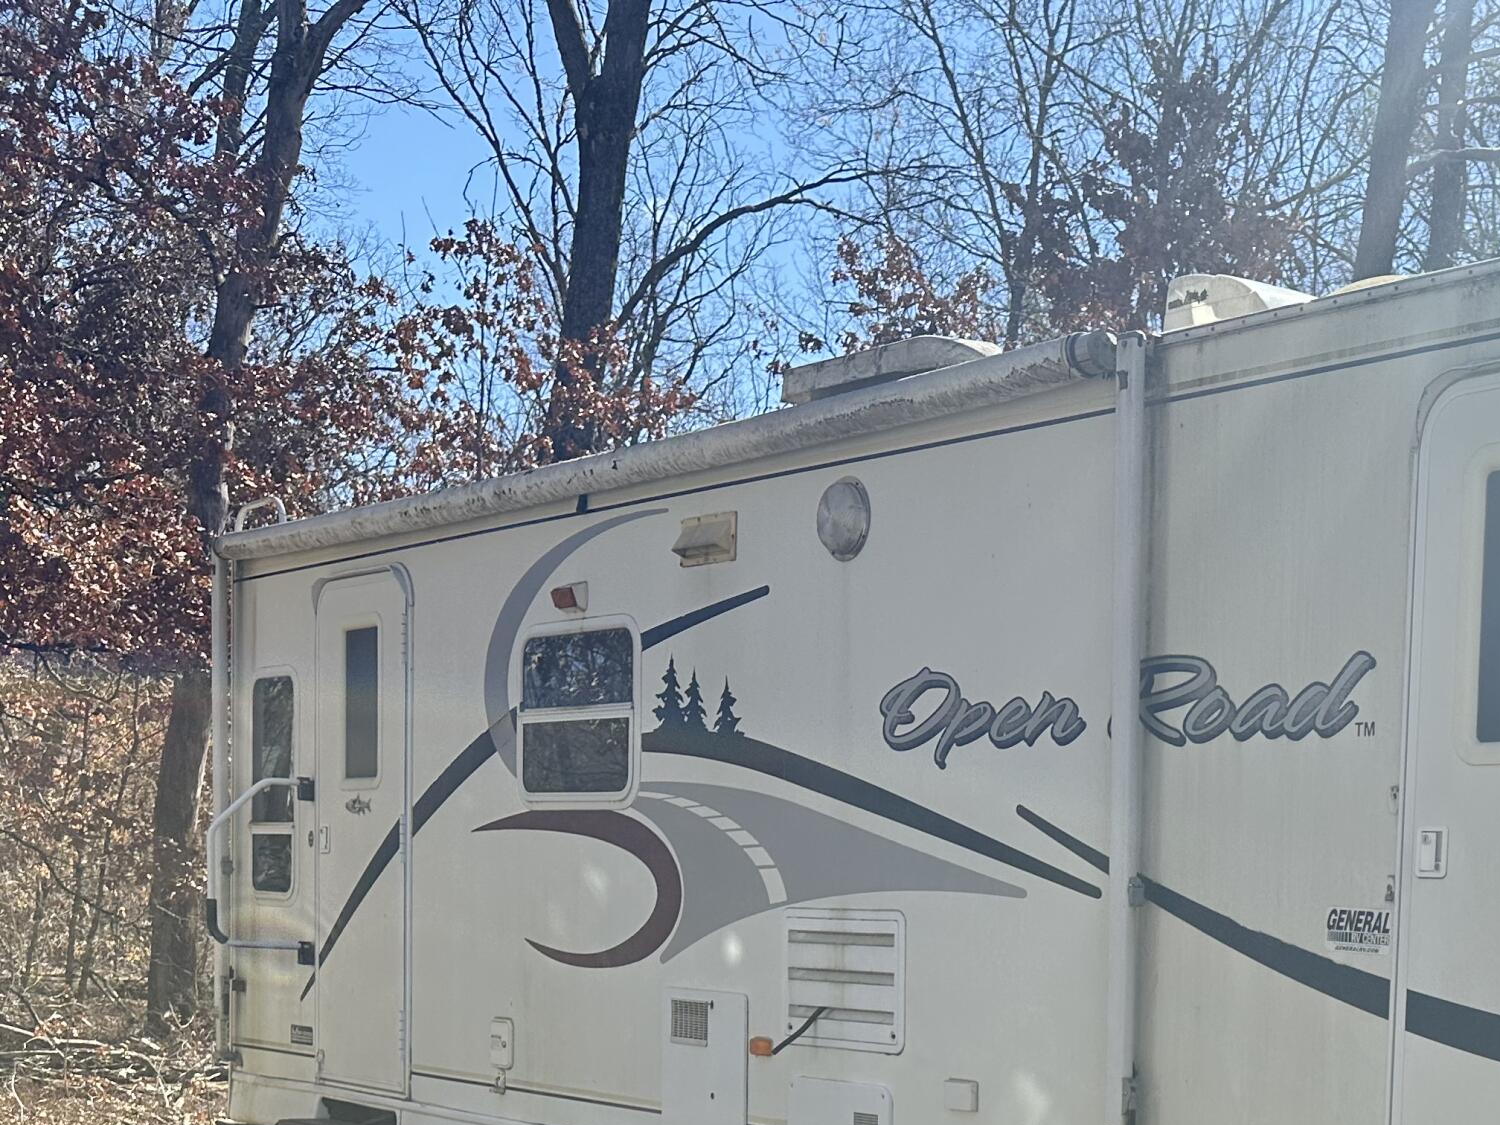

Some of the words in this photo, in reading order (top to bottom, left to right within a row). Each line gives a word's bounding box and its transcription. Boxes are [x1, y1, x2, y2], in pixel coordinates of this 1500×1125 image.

[880, 666, 1087, 770] Open
[1107, 650, 1376, 747] Road
[1327, 908, 1390, 933] GENERAL
